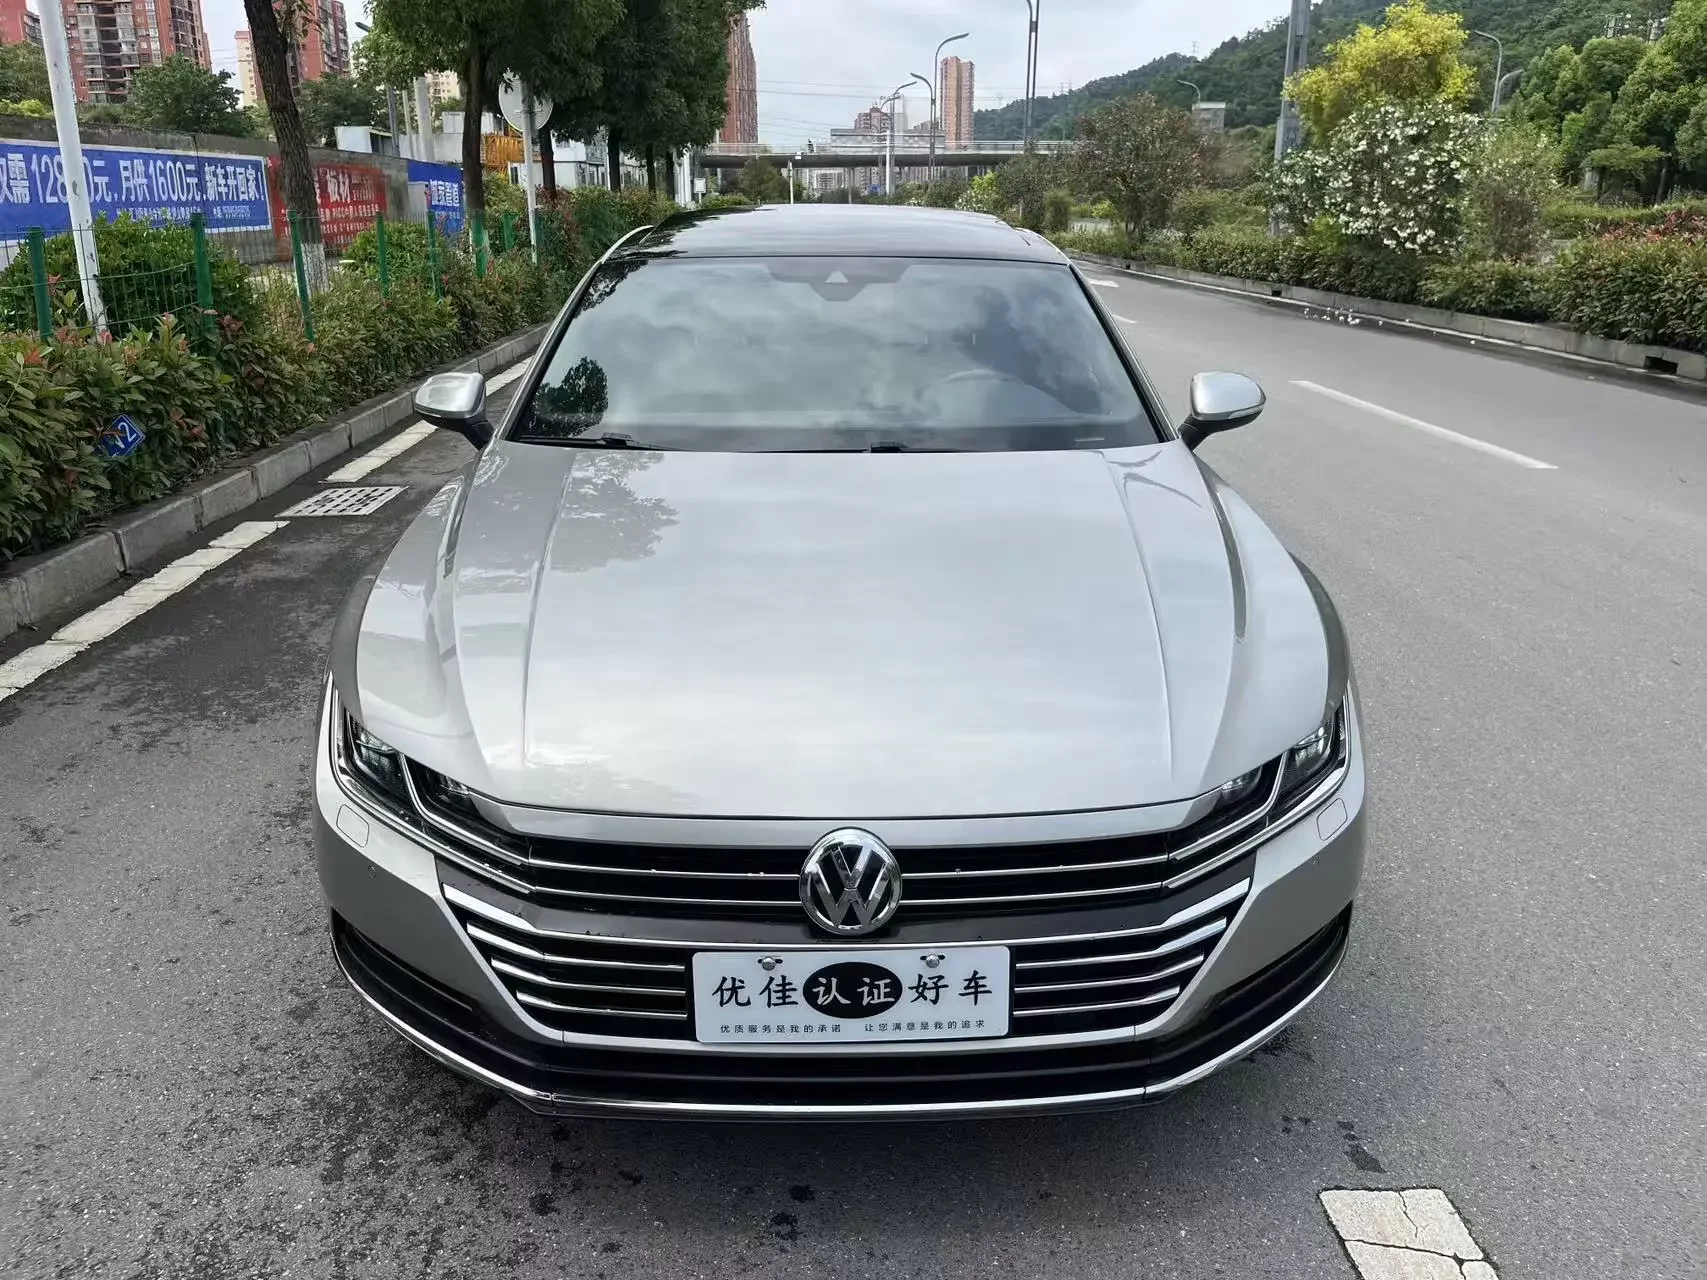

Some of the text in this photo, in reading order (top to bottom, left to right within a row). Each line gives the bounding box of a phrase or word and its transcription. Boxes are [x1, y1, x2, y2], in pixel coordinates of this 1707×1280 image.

[712, 970, 992, 1008] 优佳认证好车
[720, 1019, 985, 1034] 优质服务是我的承诺 让您满意是我的追求
